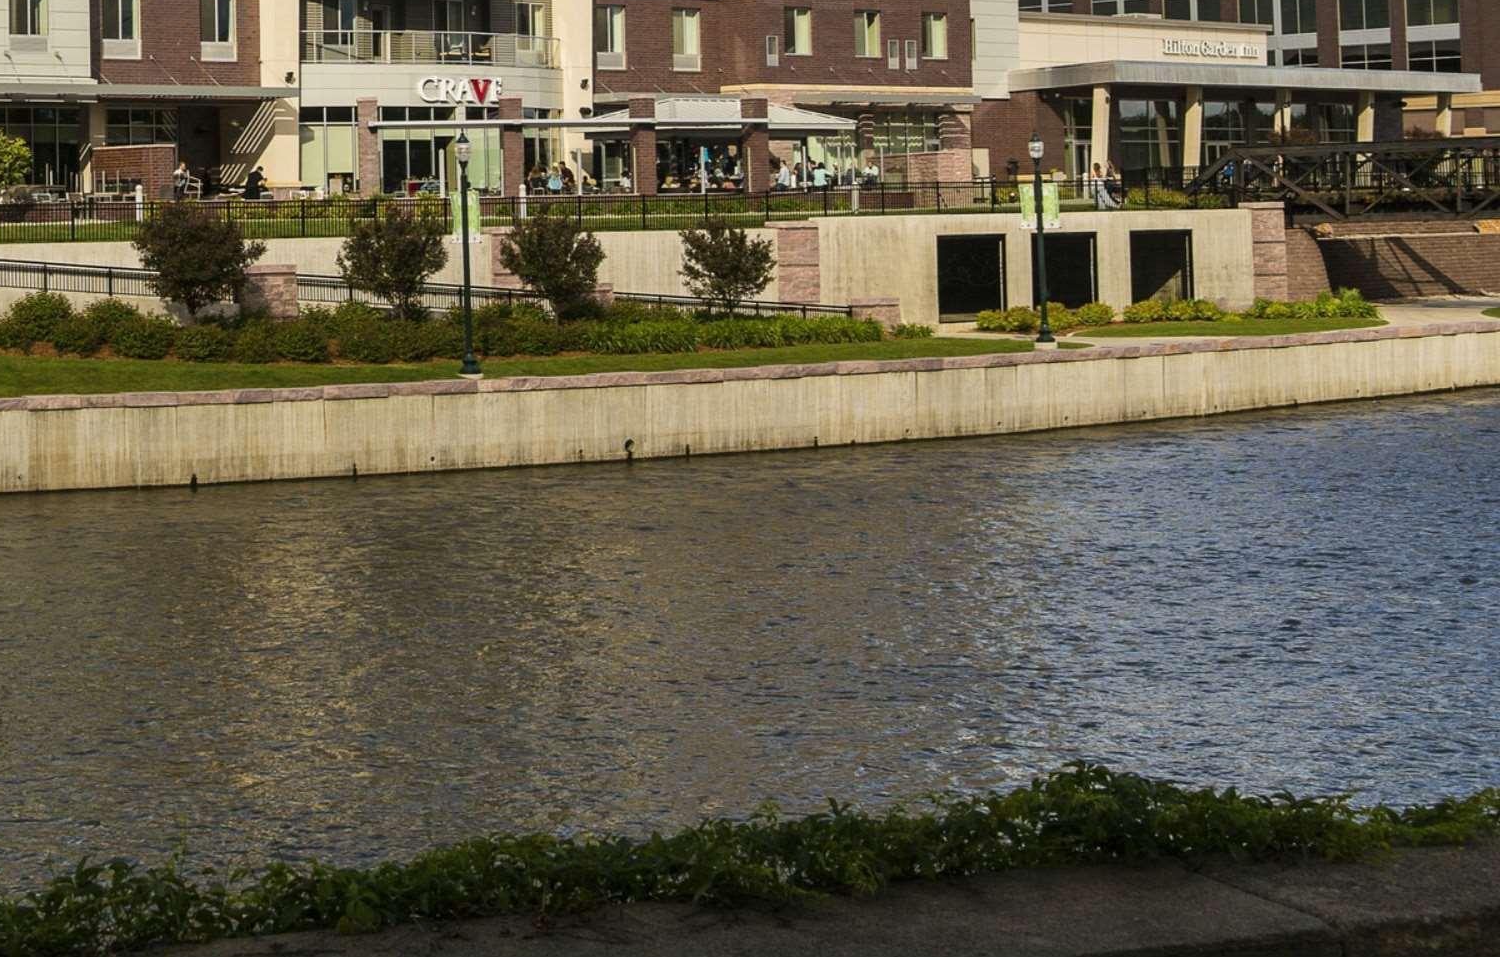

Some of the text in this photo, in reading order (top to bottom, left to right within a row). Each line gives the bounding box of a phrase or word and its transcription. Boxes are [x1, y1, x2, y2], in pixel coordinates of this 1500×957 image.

[1162, 38, 1259, 58] Hilton Garden Inn
[419, 76, 502, 105] CRAVE
